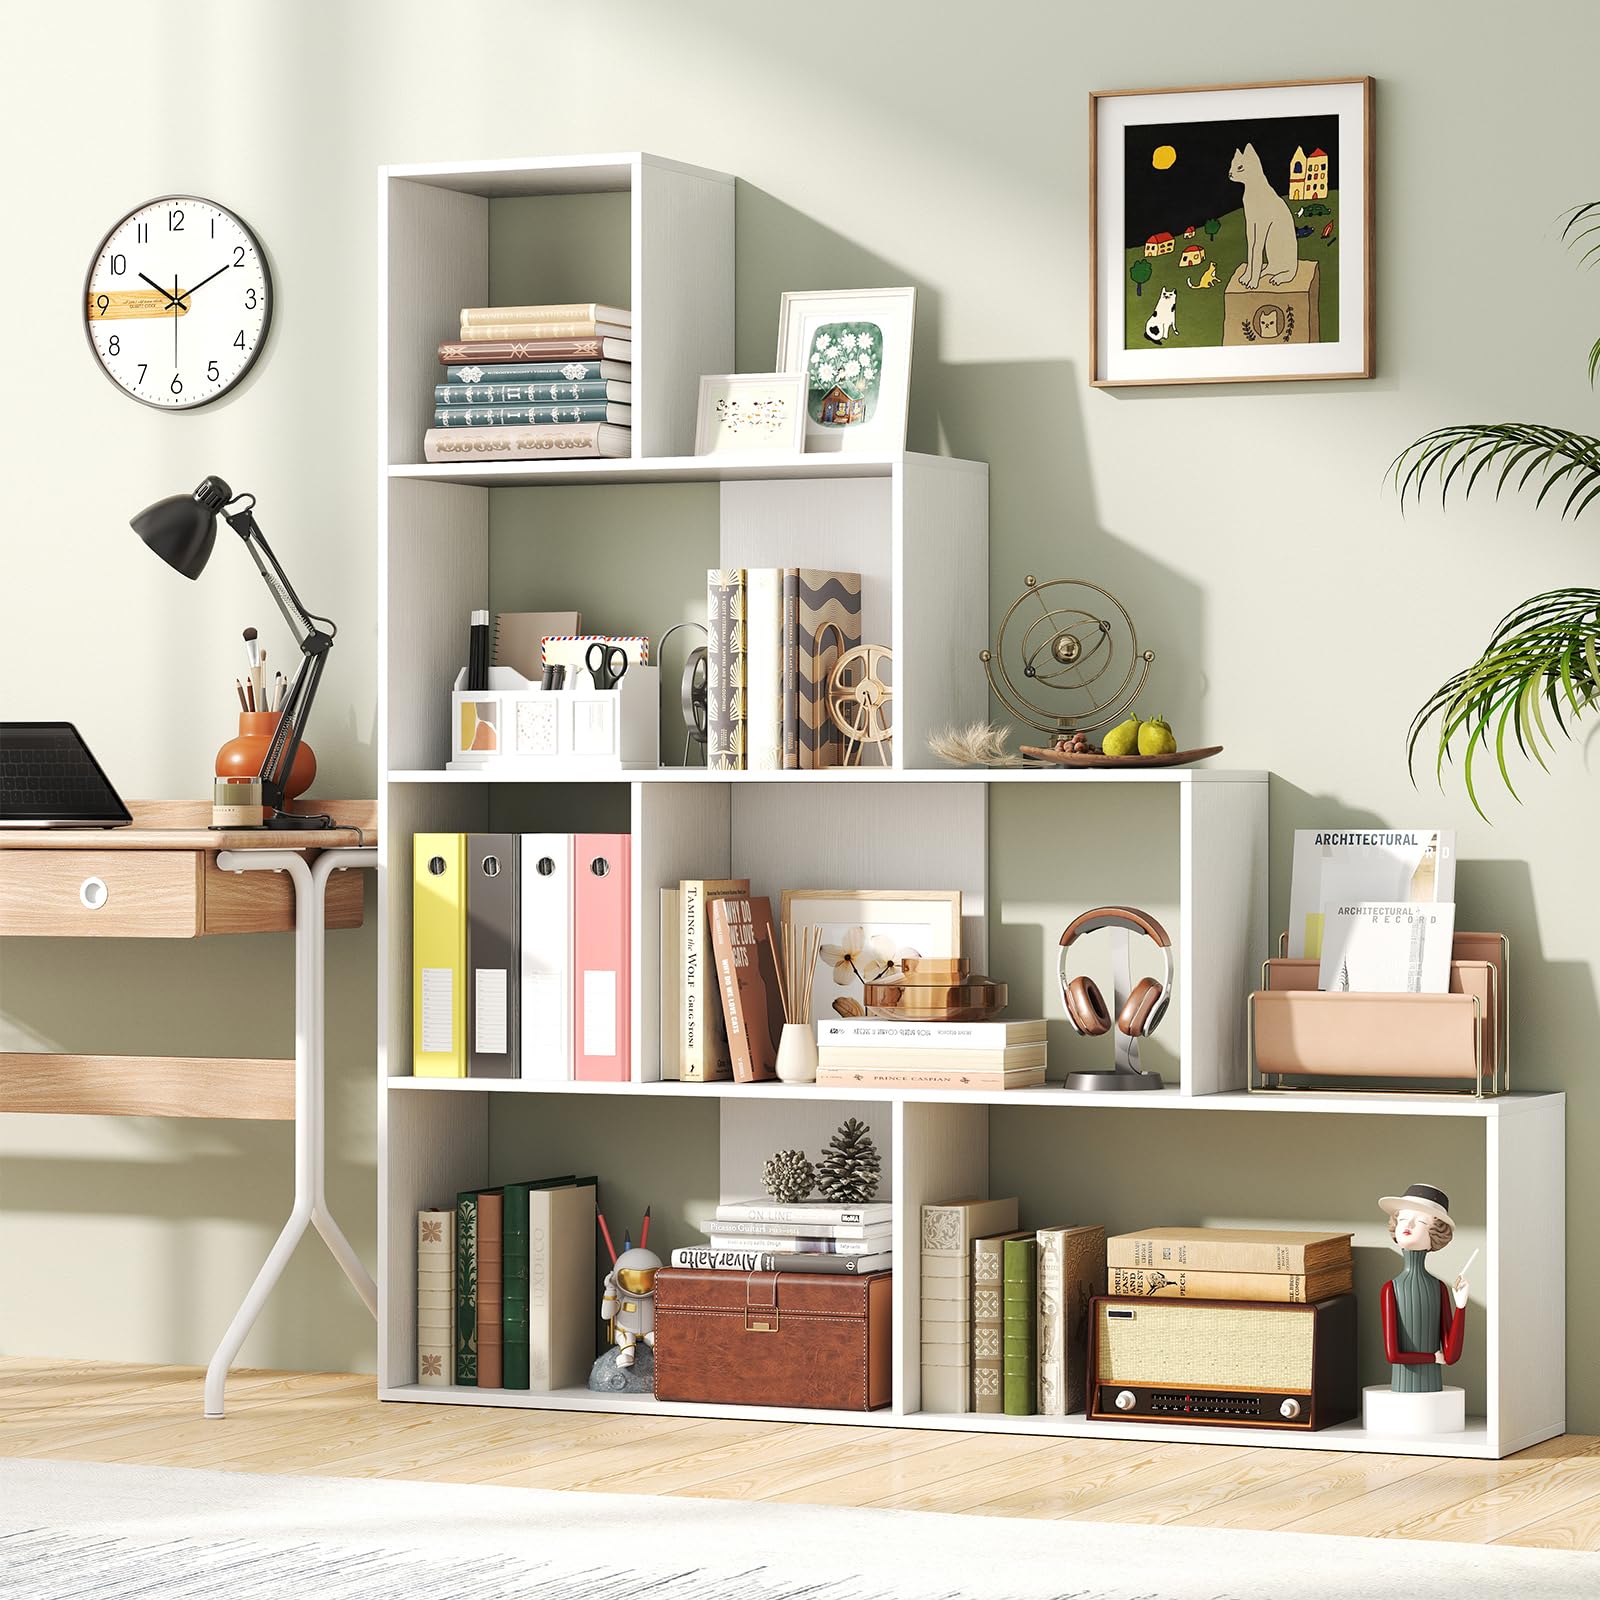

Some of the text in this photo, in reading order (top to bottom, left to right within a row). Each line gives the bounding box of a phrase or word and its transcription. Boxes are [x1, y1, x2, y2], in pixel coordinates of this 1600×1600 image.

[169, 210, 185, 231] 12
[137, 223, 148, 243] 11
[111, 254, 126, 275] 10
[233, 246, 245, 267] 2
[97, 294, 110, 316] 9
[245, 288, 257, 310] 3
[108, 334, 120, 356] 8
[233, 329, 246, 350] 4
[137, 364, 148, 384] 7
[207, 360, 220, 382] 5
[170, 373, 183, 394] 6
[1315, 833, 1418, 846] ARCHITECTURAL
[726, 900, 741, 923] WHY
[740, 900, 752, 923] DO
[1338, 907, 1413, 915] ARCHITECTURAL
[729, 924, 756, 945] WE LOVE
[732, 946, 749, 967] CATS
[687, 886, 698, 1049] TAMING the WOLF GREG STONE
[721, 959, 740, 1034] WHY DO WE LOVE CATS
[748, 1210, 793, 1221] ON LINE
[710, 1223, 737, 1232] Picasso
